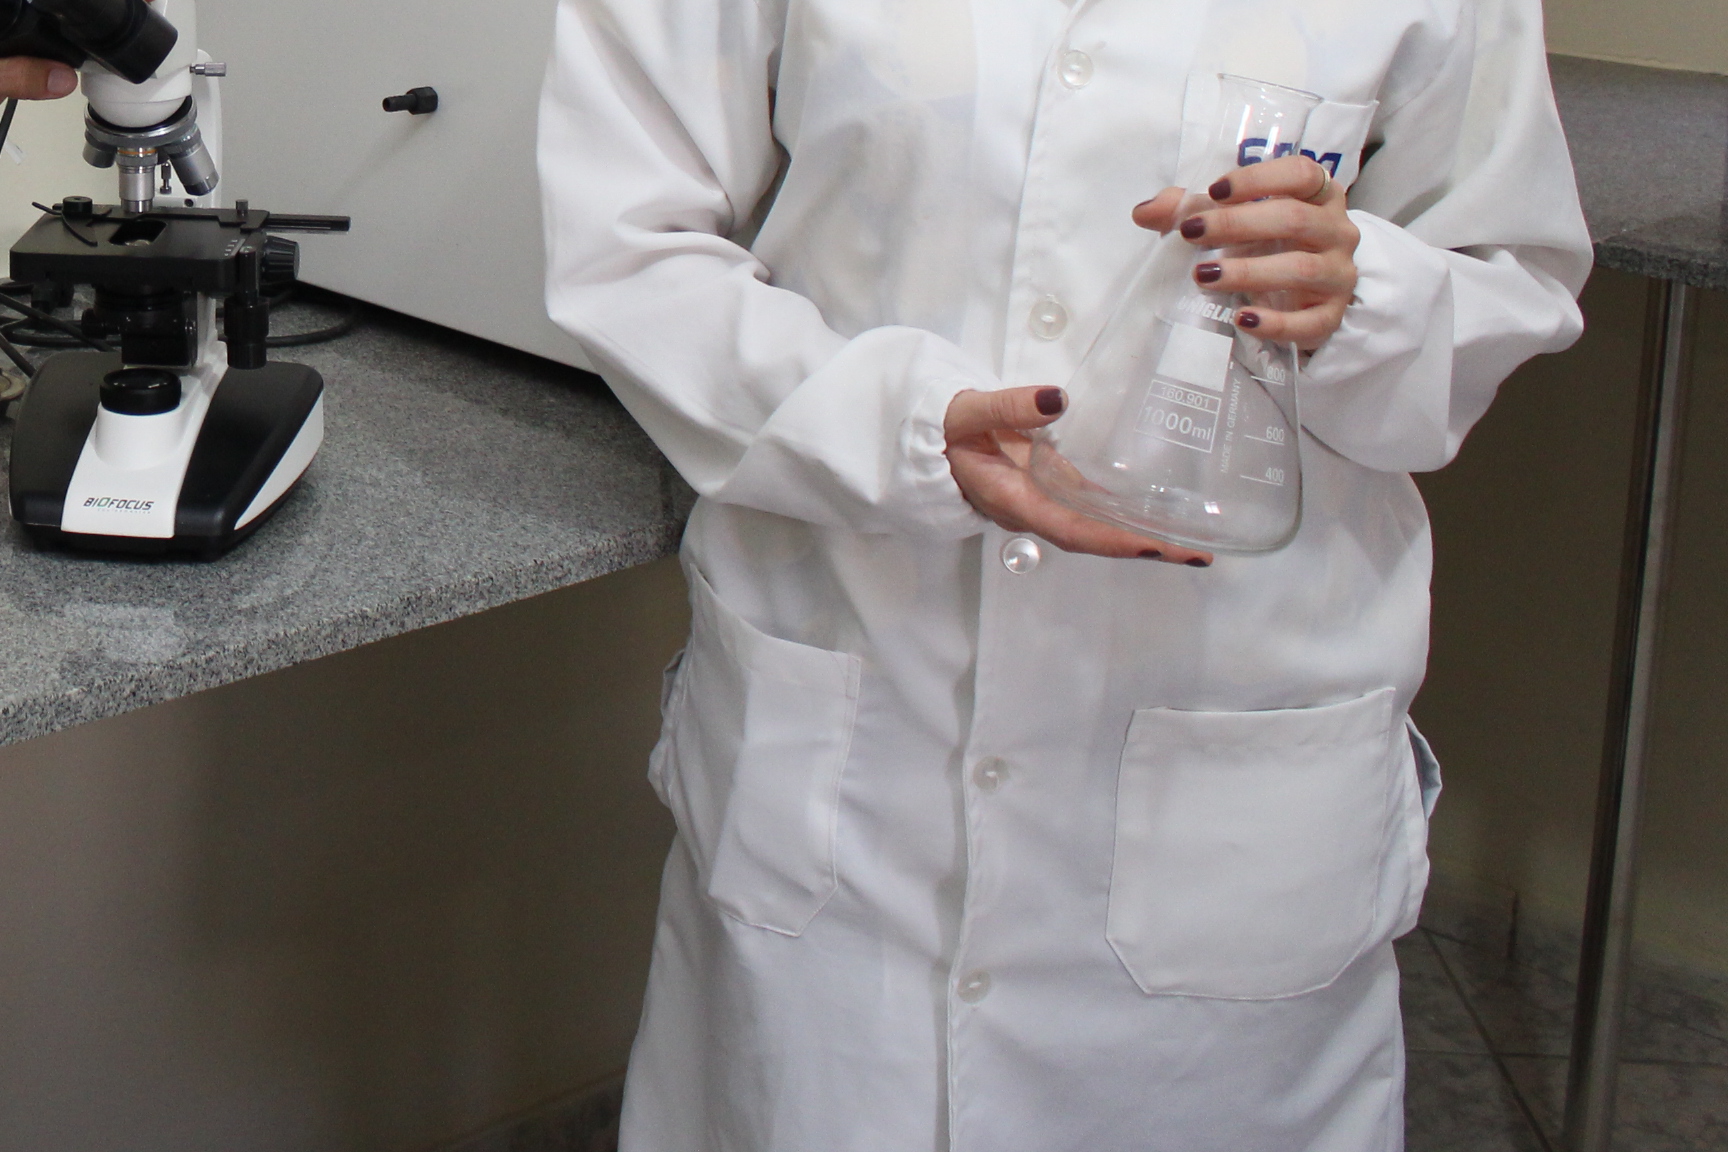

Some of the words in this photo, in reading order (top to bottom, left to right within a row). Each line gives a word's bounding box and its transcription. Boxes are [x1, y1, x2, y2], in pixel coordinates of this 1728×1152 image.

[1266, 367, 1286, 383] 800
[1227, 378, 1241, 428] GERMANY
[1225, 430, 1234, 442] IN
[1265, 426, 1285, 442] 600
[1265, 466, 1285, 483] 400
[83, 497, 155, 510] BIOFOCUS
